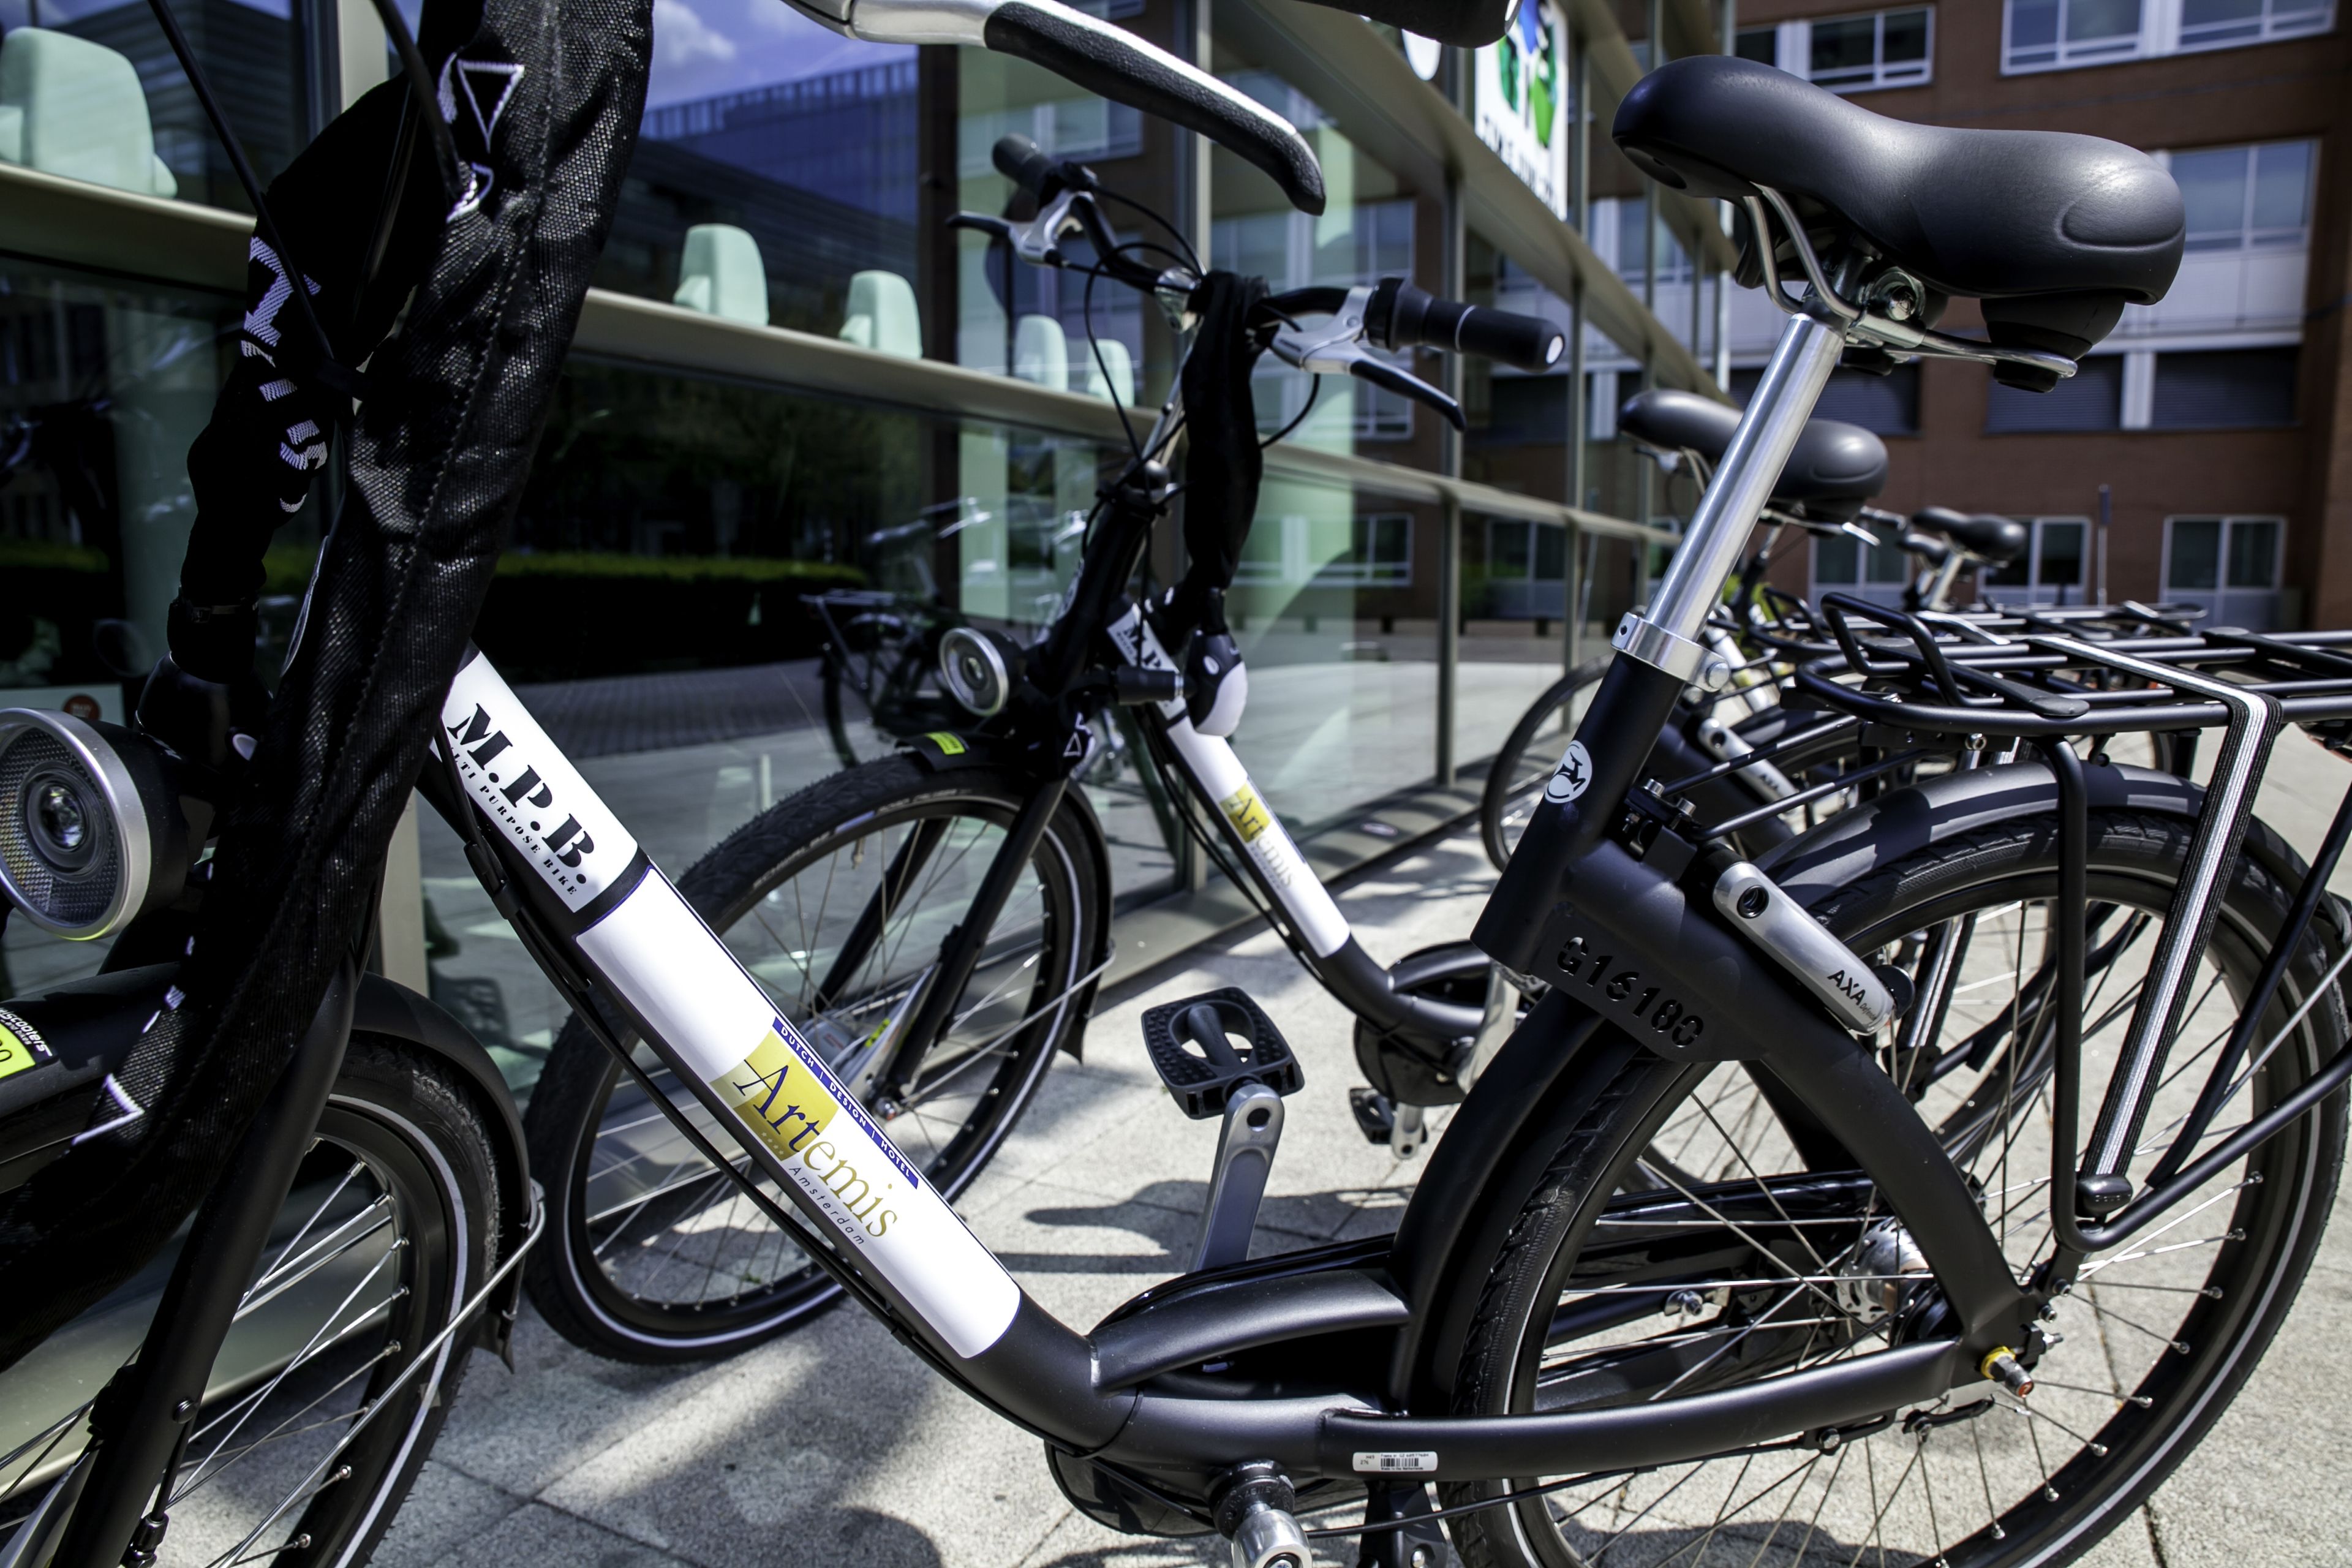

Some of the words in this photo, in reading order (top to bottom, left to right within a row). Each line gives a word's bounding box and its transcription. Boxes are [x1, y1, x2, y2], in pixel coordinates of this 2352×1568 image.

[447, 703, 594, 884] M.P.B.
[480, 785, 541, 854] PURPOSE
[543, 859, 577, 896] BIKE
[1827, 970, 1866, 1006] AXA
[733, 1059, 898, 1238] Artemis
[780, 1026, 815, 1068] DUTCH
[829, 1082, 867, 1127] DESIGN
[881, 1140, 911, 1178] HOTEL
[789, 1166, 865, 1245] Amsterdam
